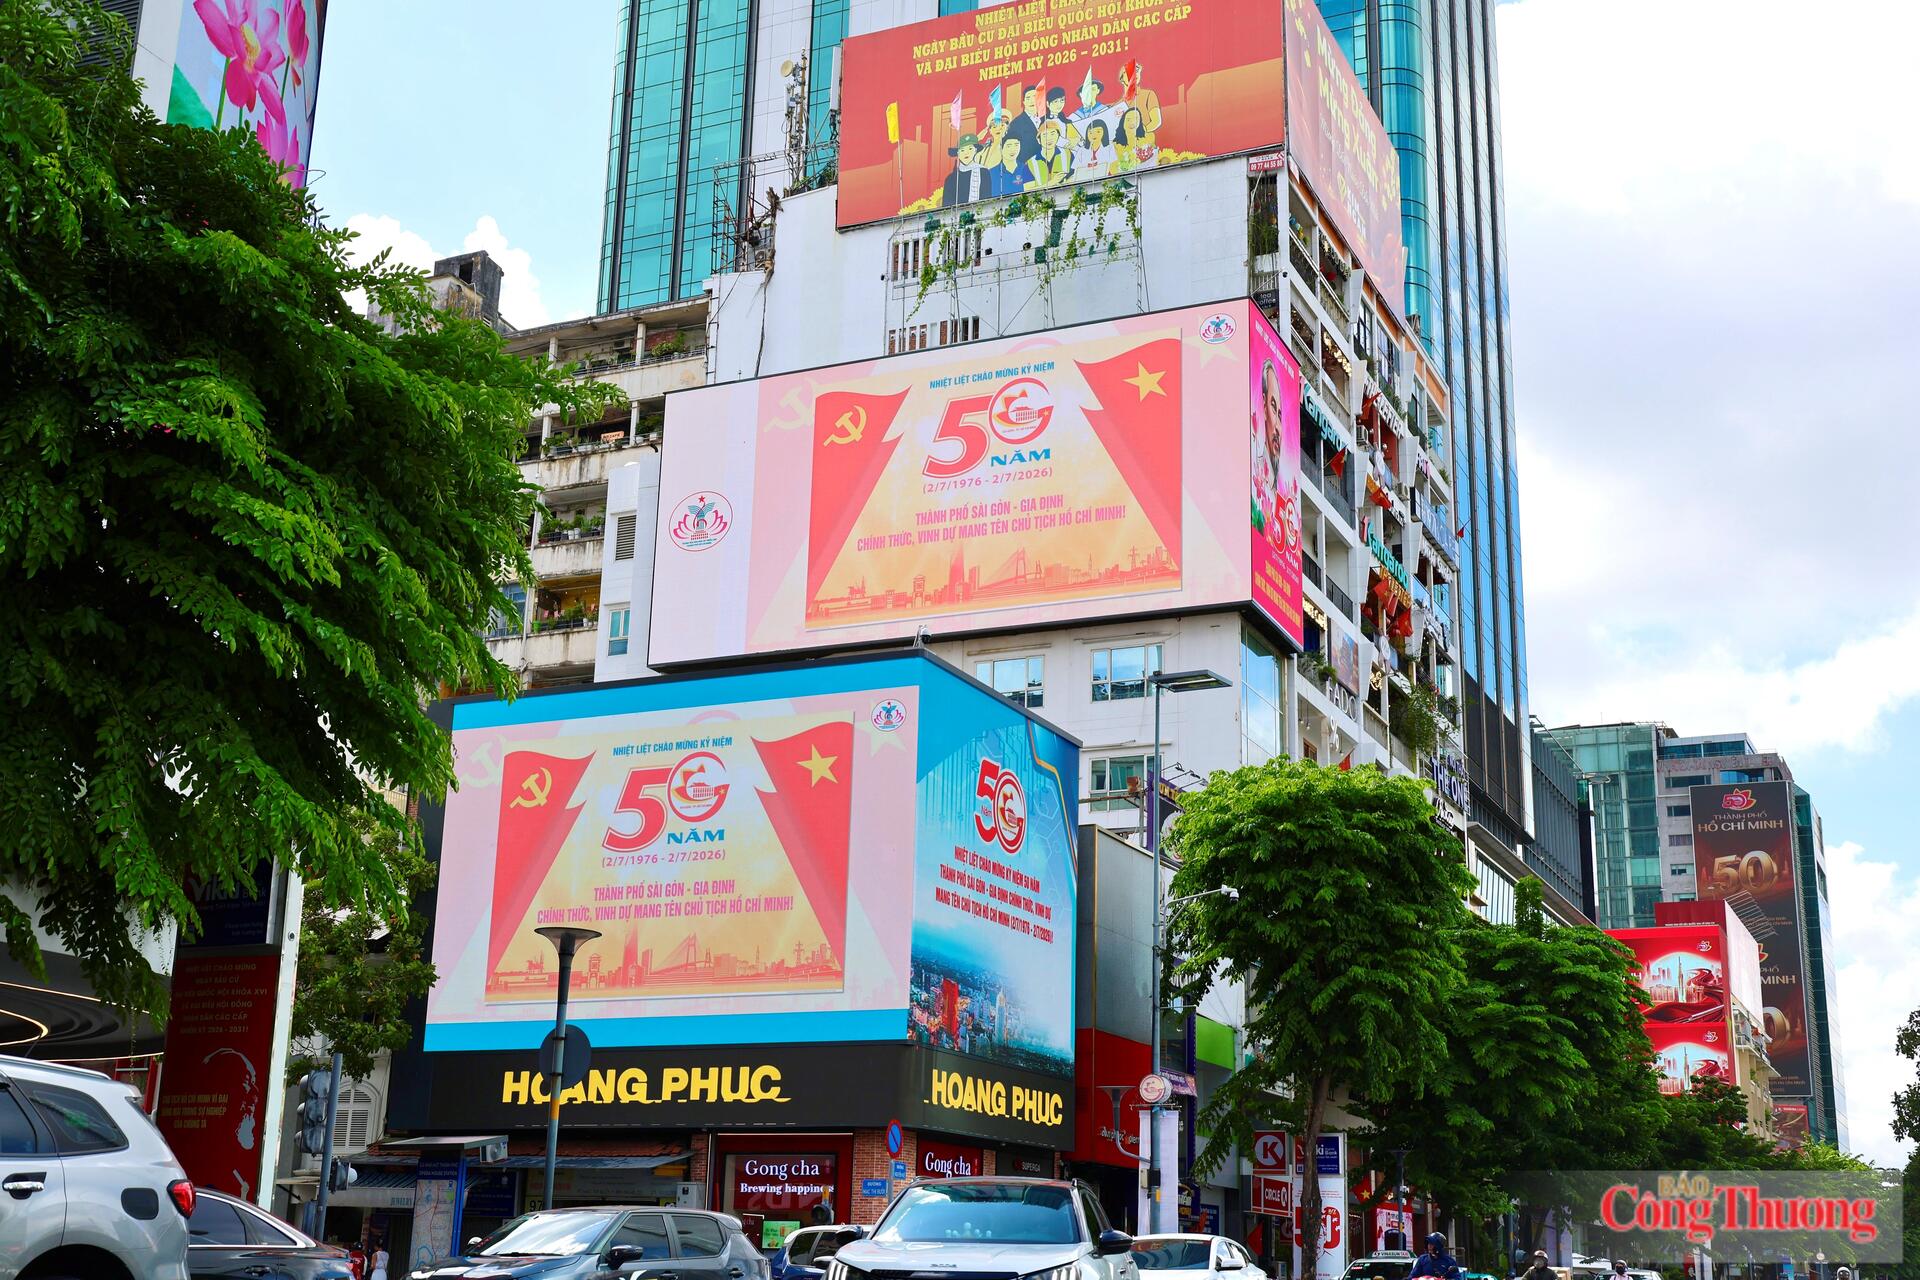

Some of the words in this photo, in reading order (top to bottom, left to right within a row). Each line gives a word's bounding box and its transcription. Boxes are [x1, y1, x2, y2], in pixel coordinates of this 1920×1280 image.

[975, 6, 1015, 27] NHIỆT
[1018, 0, 1047, 18] LIỆT
[913, 39, 947, 59] NGÀY
[950, 31, 976, 50] BẦU
[998, 23, 1021, 41] ĐẠI
[1023, 14, 1054, 35] BIỂU
[1058, 8, 1094, 29] QUỐC
[1097, 2, 1122, 19] HỘI
[915, 57, 933, 77] VÀ
[935, 57, 958, 73] ĐẠI
[960, 46, 991, 68] BIỂU
[993, 42, 1018, 60] HỘI
[1021, 33, 1058, 54] ĐỒNG
[1061, 25, 1099, 45] NHÂN
[1102, 18, 1131, 36] DÂN
[1133, 11, 1161, 29] CÁC
[1164, 3, 1192, 23] CẤP
[979, 59, 1023, 82] NHIỆM
[1047, 48, 1077, 67] 2026
[929, 376, 952, 390] NHIỆT
[954, 374, 970, 387] LIỆT
[971, 369, 993, 382] CHÀO
[995, 366, 1019, 379] MỪNG
[1033, 361, 1055, 373] NIỆM
[990, 447, 1051, 467] NĂM
[922, 477, 982, 494] (2/7/1976
[992, 467, 1053, 485] 2/7/2026)
[916, 509, 946, 526] THÀNH
[949, 502, 969, 521] PHỐ
[971, 501, 988, 519] SÀI
[990, 499, 1011, 517] GÒN
[1020, 497, 1036, 513] GIA
[1039, 494, 1063, 511] ĐỊNH
[857, 533, 886, 552] CHÍNH
[917, 528, 940, 544] VINH
[942, 526, 956, 543] DỰ
[958, 523, 988, 540] MANG
[990, 518, 1009, 535] TÊN
[1011, 514, 1032, 533] CHỦ
[1034, 513, 1056, 532] TỊCH
[1059, 507, 1073, 526] HỒ
[1075, 506, 1093, 524] CHÍ
[1095, 504, 1127, 521] MINH!
[613, 744, 634, 757] NHIỆT
[636, 743, 652, 755] LIỆT
[653, 740, 674, 752] CHÀO
[675, 739, 698, 750] MỪNG
[712, 736, 733, 747] NIỆM
[1698, 819, 1718, 833] HỒ
[1720, 818, 1745, 831] CHÍ
[1747, 819, 1783, 830] MINH
[1713, 811, 1746, 820] THÀNH
[1747, 810, 1767, 818] PHỐ
[667, 828, 725, 844] NĂM
[602, 854, 658, 868] (2/7/1976
[668, 849, 726, 863] 2/7/2026)
[1713, 850, 1778, 893] 50
[594, 886, 624, 902] THÀNH
[626, 882, 645, 899] PHỐ
[647, 883, 662, 898] SÀI
[665, 881, 684, 897] GÒN
[693, 880, 709, 895] GIA
[711, 879, 735, 897] ĐỊNH
[537, 906, 564, 924] CHÍNH
[595, 906, 616, 921] VINH
[618, 904, 632, 922] DỰ
[634, 903, 662, 919] MANG
[664, 899, 682, 917] TÊN
[684, 898, 703, 916] CHỦ
[706, 898, 726, 918] TỊCH
[729, 895, 742, 913] HỒ
[745, 895, 761, 912] CHÍ
[764, 896, 794, 911] MINH!
[661, 1064, 792, 1103] PHUC
[931, 1068, 1007, 1117] HOANG
[1012, 1085, 1063, 1126] PHUC
[925, 1151, 953, 1178] Gong
[954, 1156, 971, 1176] cha
[1263, 1141, 1281, 1162] K
[745, 1160, 788, 1180] Gong
[791, 1159, 820, 1175] cha
[1022, 1161, 1041, 1172] SUPERGA
[740, 1183, 783, 1195] Brewing
[1264, 1188, 1280, 1202] CIRCLE
